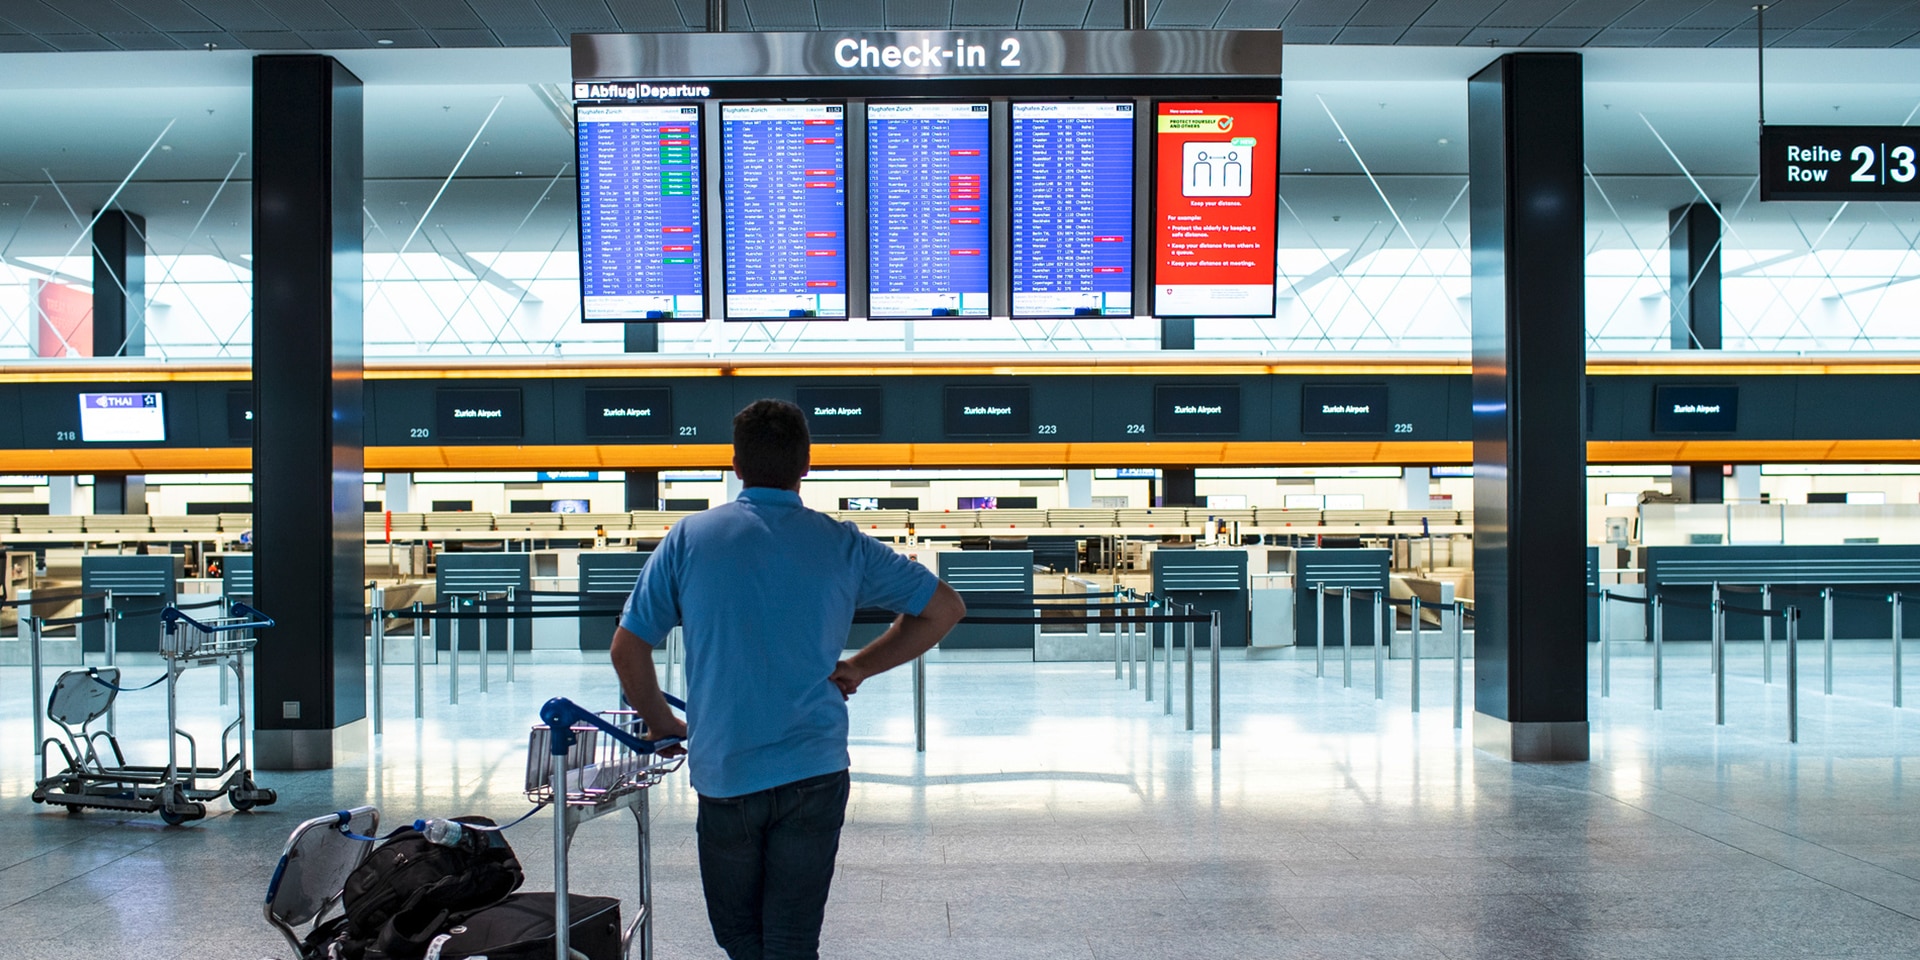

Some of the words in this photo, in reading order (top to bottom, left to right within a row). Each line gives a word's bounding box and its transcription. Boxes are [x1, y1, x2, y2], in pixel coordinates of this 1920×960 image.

[834, 38, 985, 68] Check-in
[1000, 37, 1021, 67] 2
[1787, 145, 1842, 162] Reihe
[1850, 145, 1876, 183] 2
[1890, 145, 1916, 183] 3
[1787, 165, 1828, 182] Row
[109, 397, 132, 406] THAI
[454, 409, 476, 418] Zurich
[477, 409, 501, 419] Airport
[603, 408, 626, 417] Zurich
[626, 408, 651, 418] Airport
[814, 407, 836, 416] Zurich
[837, 407, 862, 417] Airport
[963, 407, 986, 415] Zurich
[987, 406, 1011, 416] Airport
[1174, 406, 1196, 414] Zurich
[1197, 405, 1221, 415] Airport
[1322, 405, 1344, 414] Zurich
[1345, 405, 1369, 415] Airport
[1673, 404, 1696, 413] Zurich
[1696, 404, 1720, 414] Airport
[410, 428, 429, 438] 220
[679, 426, 697, 436] 221
[1038, 425, 1057, 434] 223
[1126, 424, 1146, 434] 224
[1394, 423, 1413, 433] 225
[57, 431, 76, 441] 218
